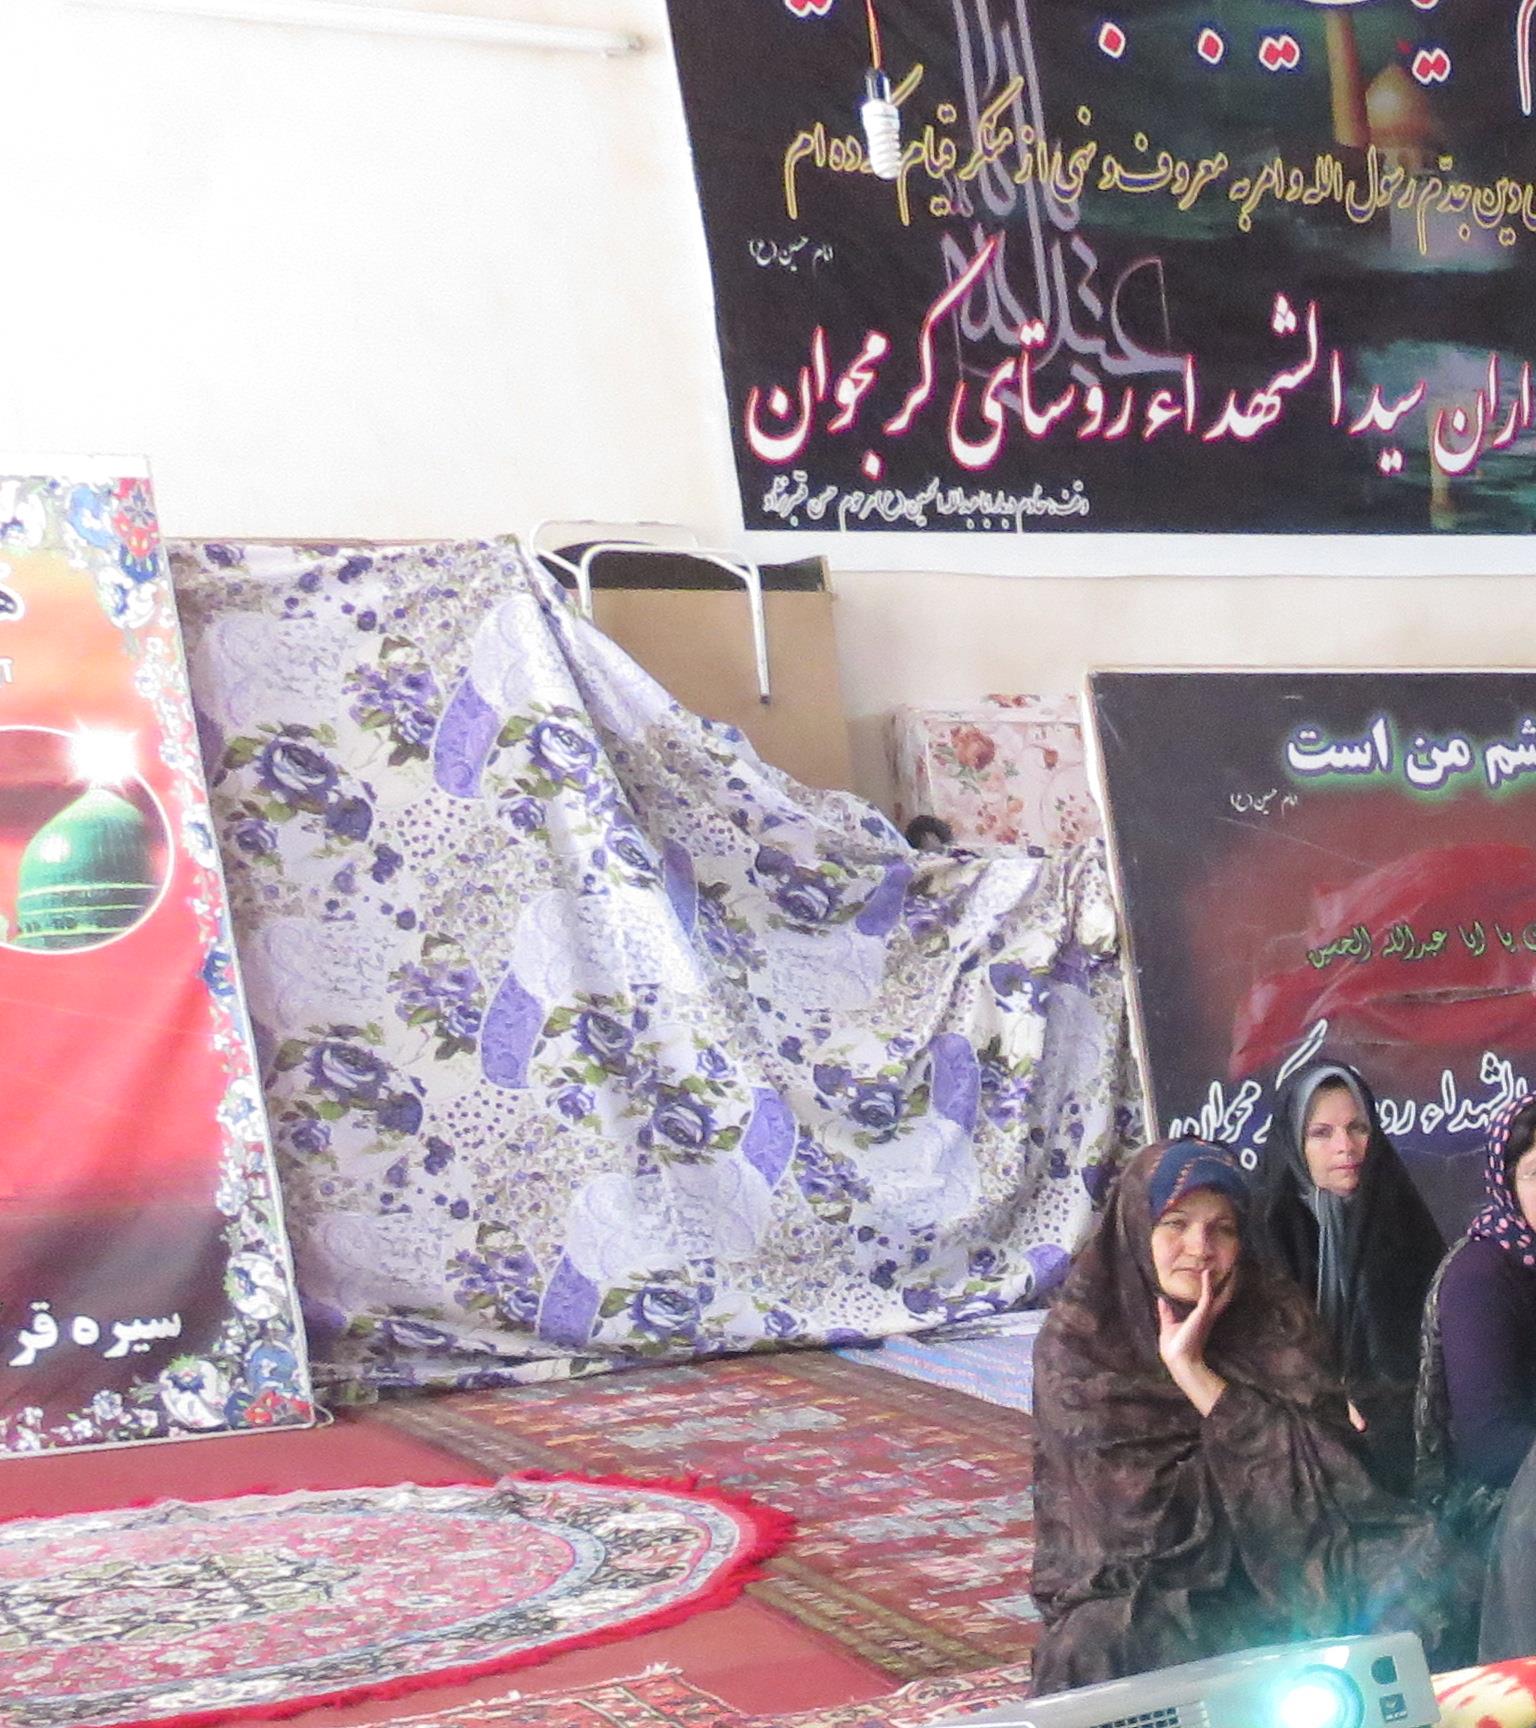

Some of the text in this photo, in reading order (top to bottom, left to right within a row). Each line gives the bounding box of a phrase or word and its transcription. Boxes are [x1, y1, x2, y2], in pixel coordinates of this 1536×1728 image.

[896, 103, 958, 227] قیام
[1303, 154, 1343, 206] الله
[1345, 144, 1417, 224] رسول
[1473, 177, 1522, 247] دین
[948, 320, 1136, 472] روستای
[1287, 717, 1391, 772] است
[1405, 729, 1472, 786] من
[7, 1301, 183, 1367] سیره قر
